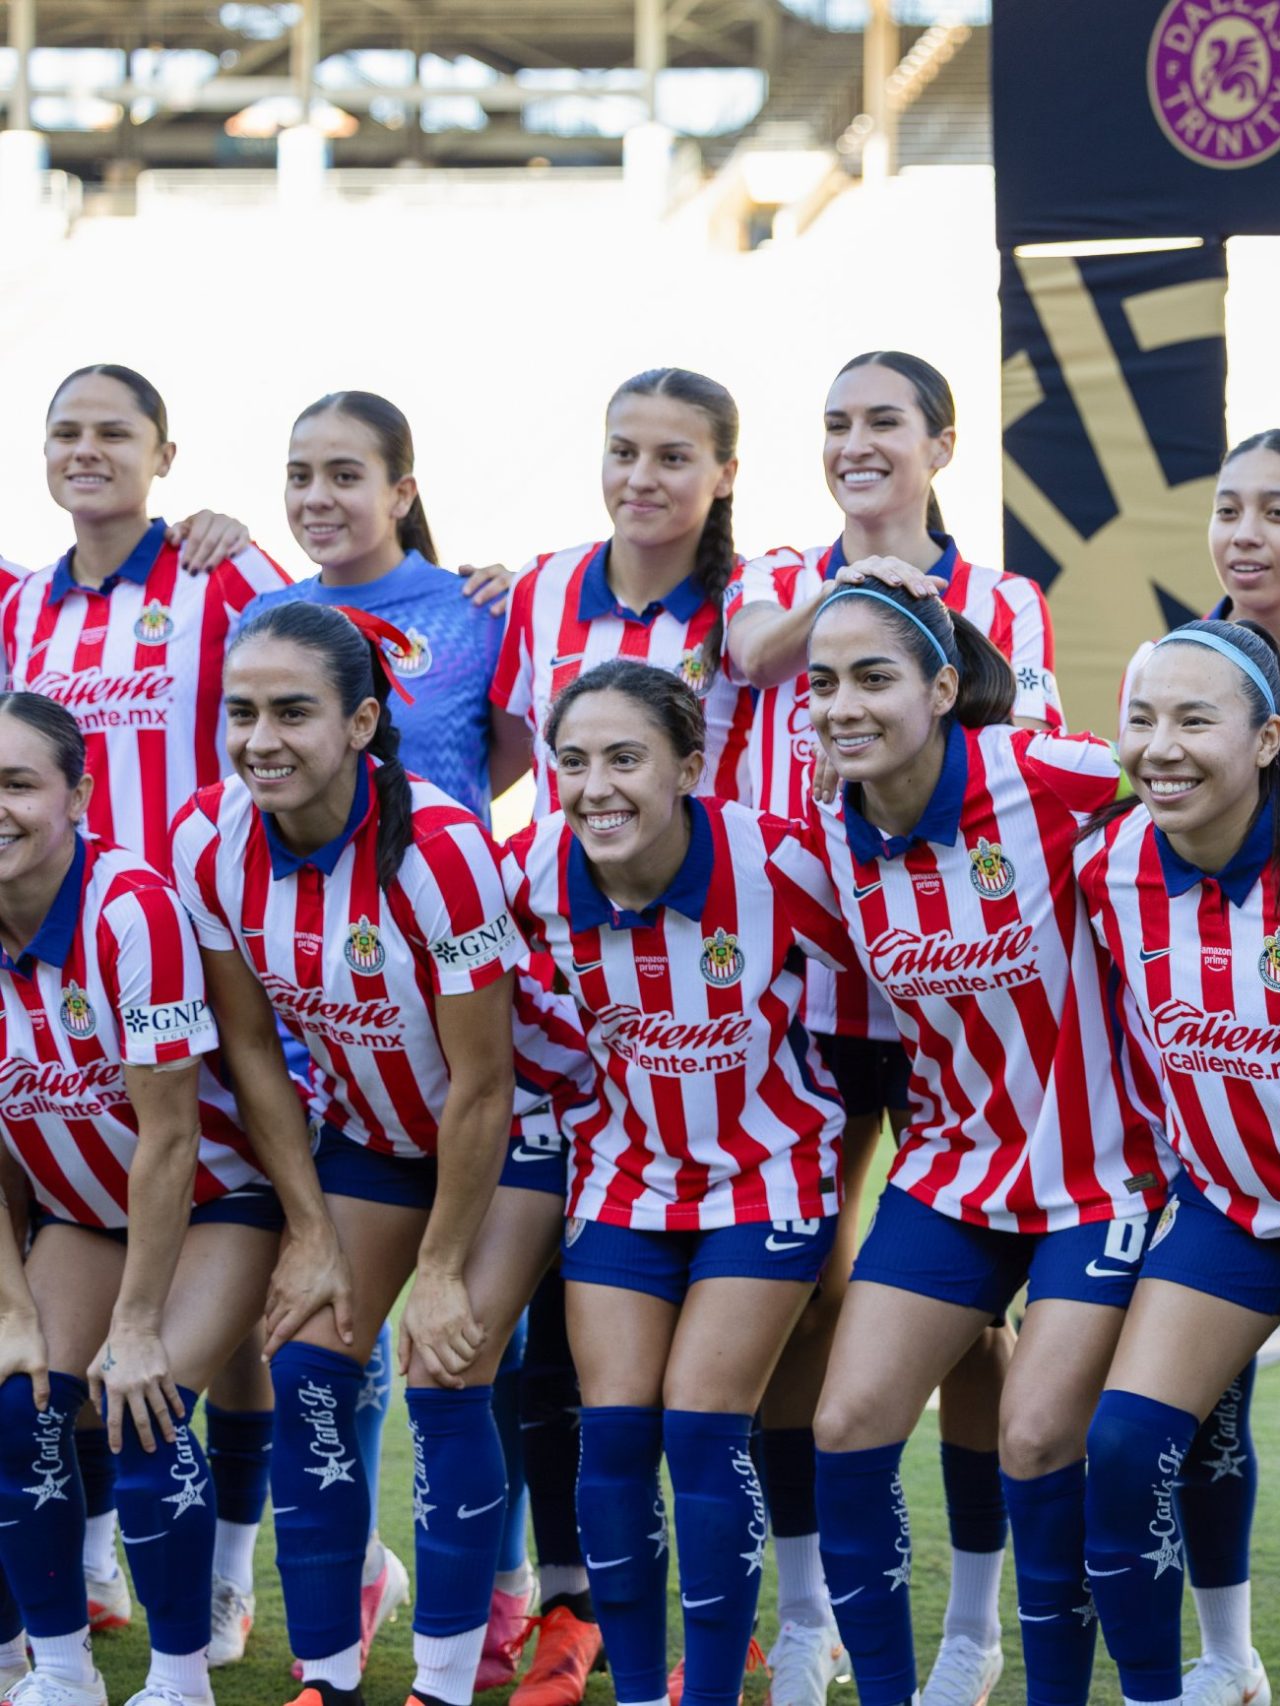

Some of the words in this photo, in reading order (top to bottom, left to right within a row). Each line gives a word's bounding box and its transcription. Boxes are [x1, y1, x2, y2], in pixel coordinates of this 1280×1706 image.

[75, 710, 168, 730] ente.mx
[461, 911, 510, 958] GNP
[867, 920, 1034, 982] Caliente
[1201, 946, 1232, 957] amazon
[892, 958, 1041, 999] caliente.mx
[1204, 955, 1229, 967] prime
[151, 999, 206, 1032] GNP
[599, 1003, 753, 1050] Caliente
[298, 1379, 338, 1409] Jr.
[300, 1408, 347, 1458] Carl's
[1149, 1478, 1177, 1538] Carl's
